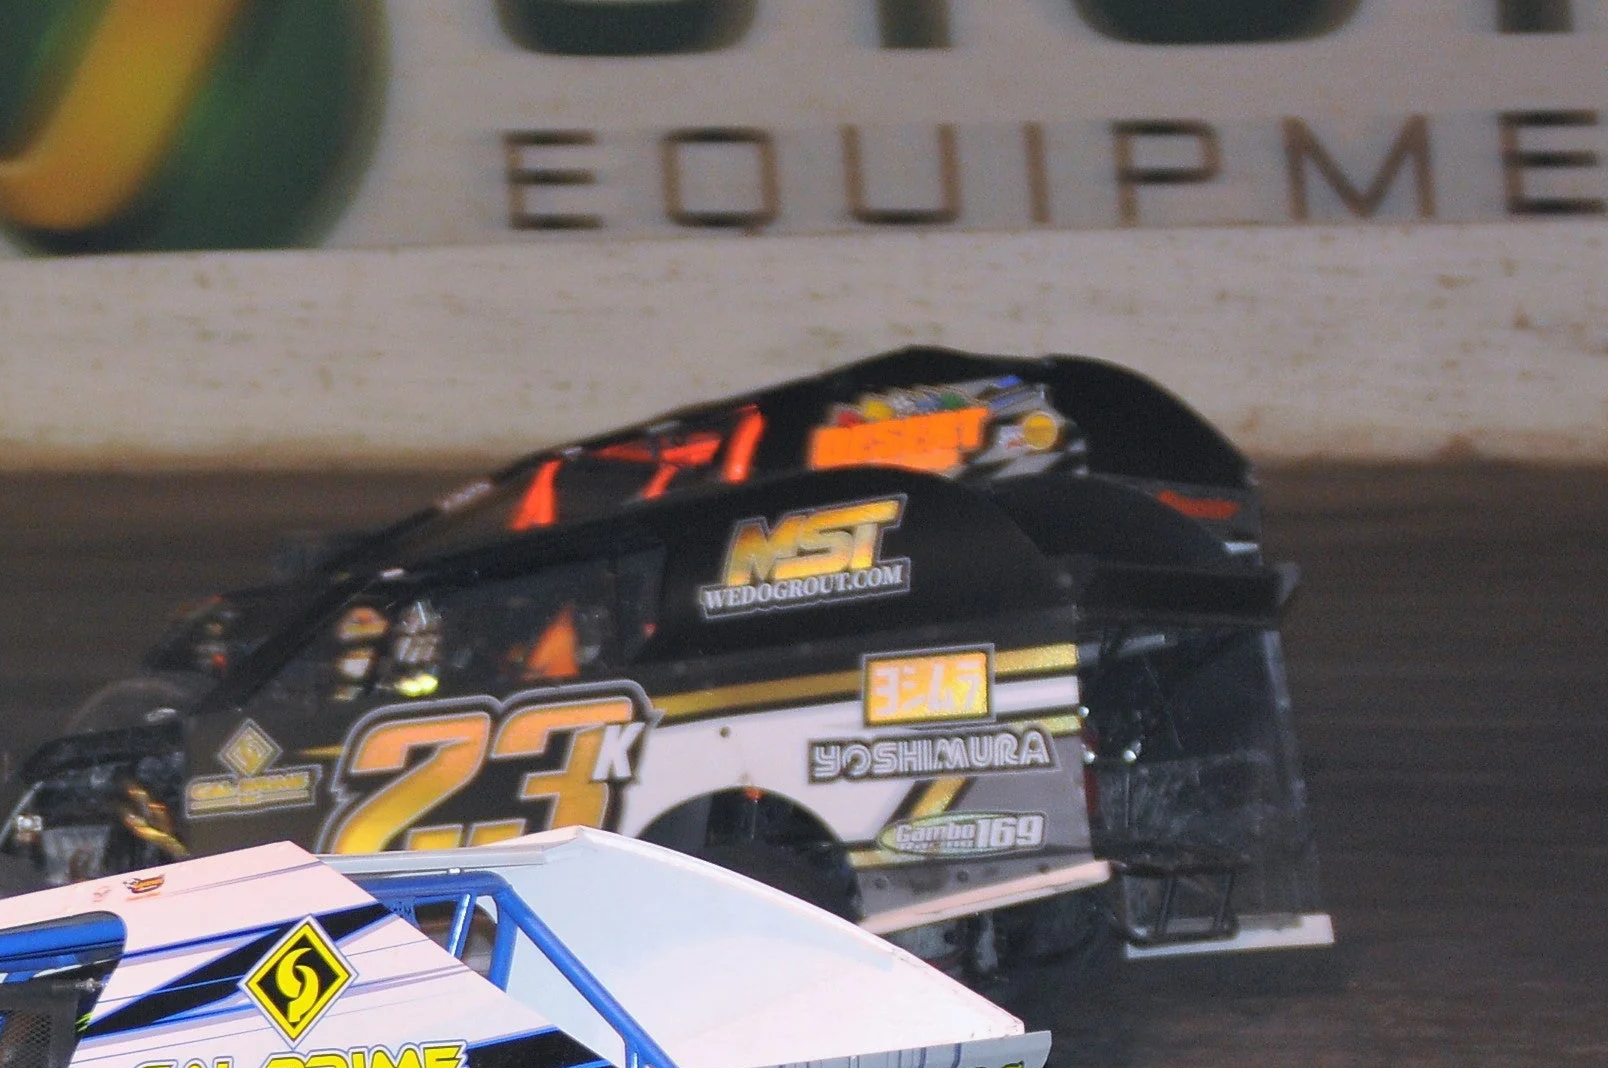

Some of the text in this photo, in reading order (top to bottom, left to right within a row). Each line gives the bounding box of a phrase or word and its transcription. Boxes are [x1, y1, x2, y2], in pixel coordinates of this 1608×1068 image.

[504, 110, 1606, 230] EQUIPME
[727, 500, 899, 585] MST
[705, 565, 903, 609] WEDOGROUT.COM
[874, 660, 981, 718] ヨシムラ
[813, 729, 1050, 779] YOSHIMURA
[975, 813, 1043, 850] 169
